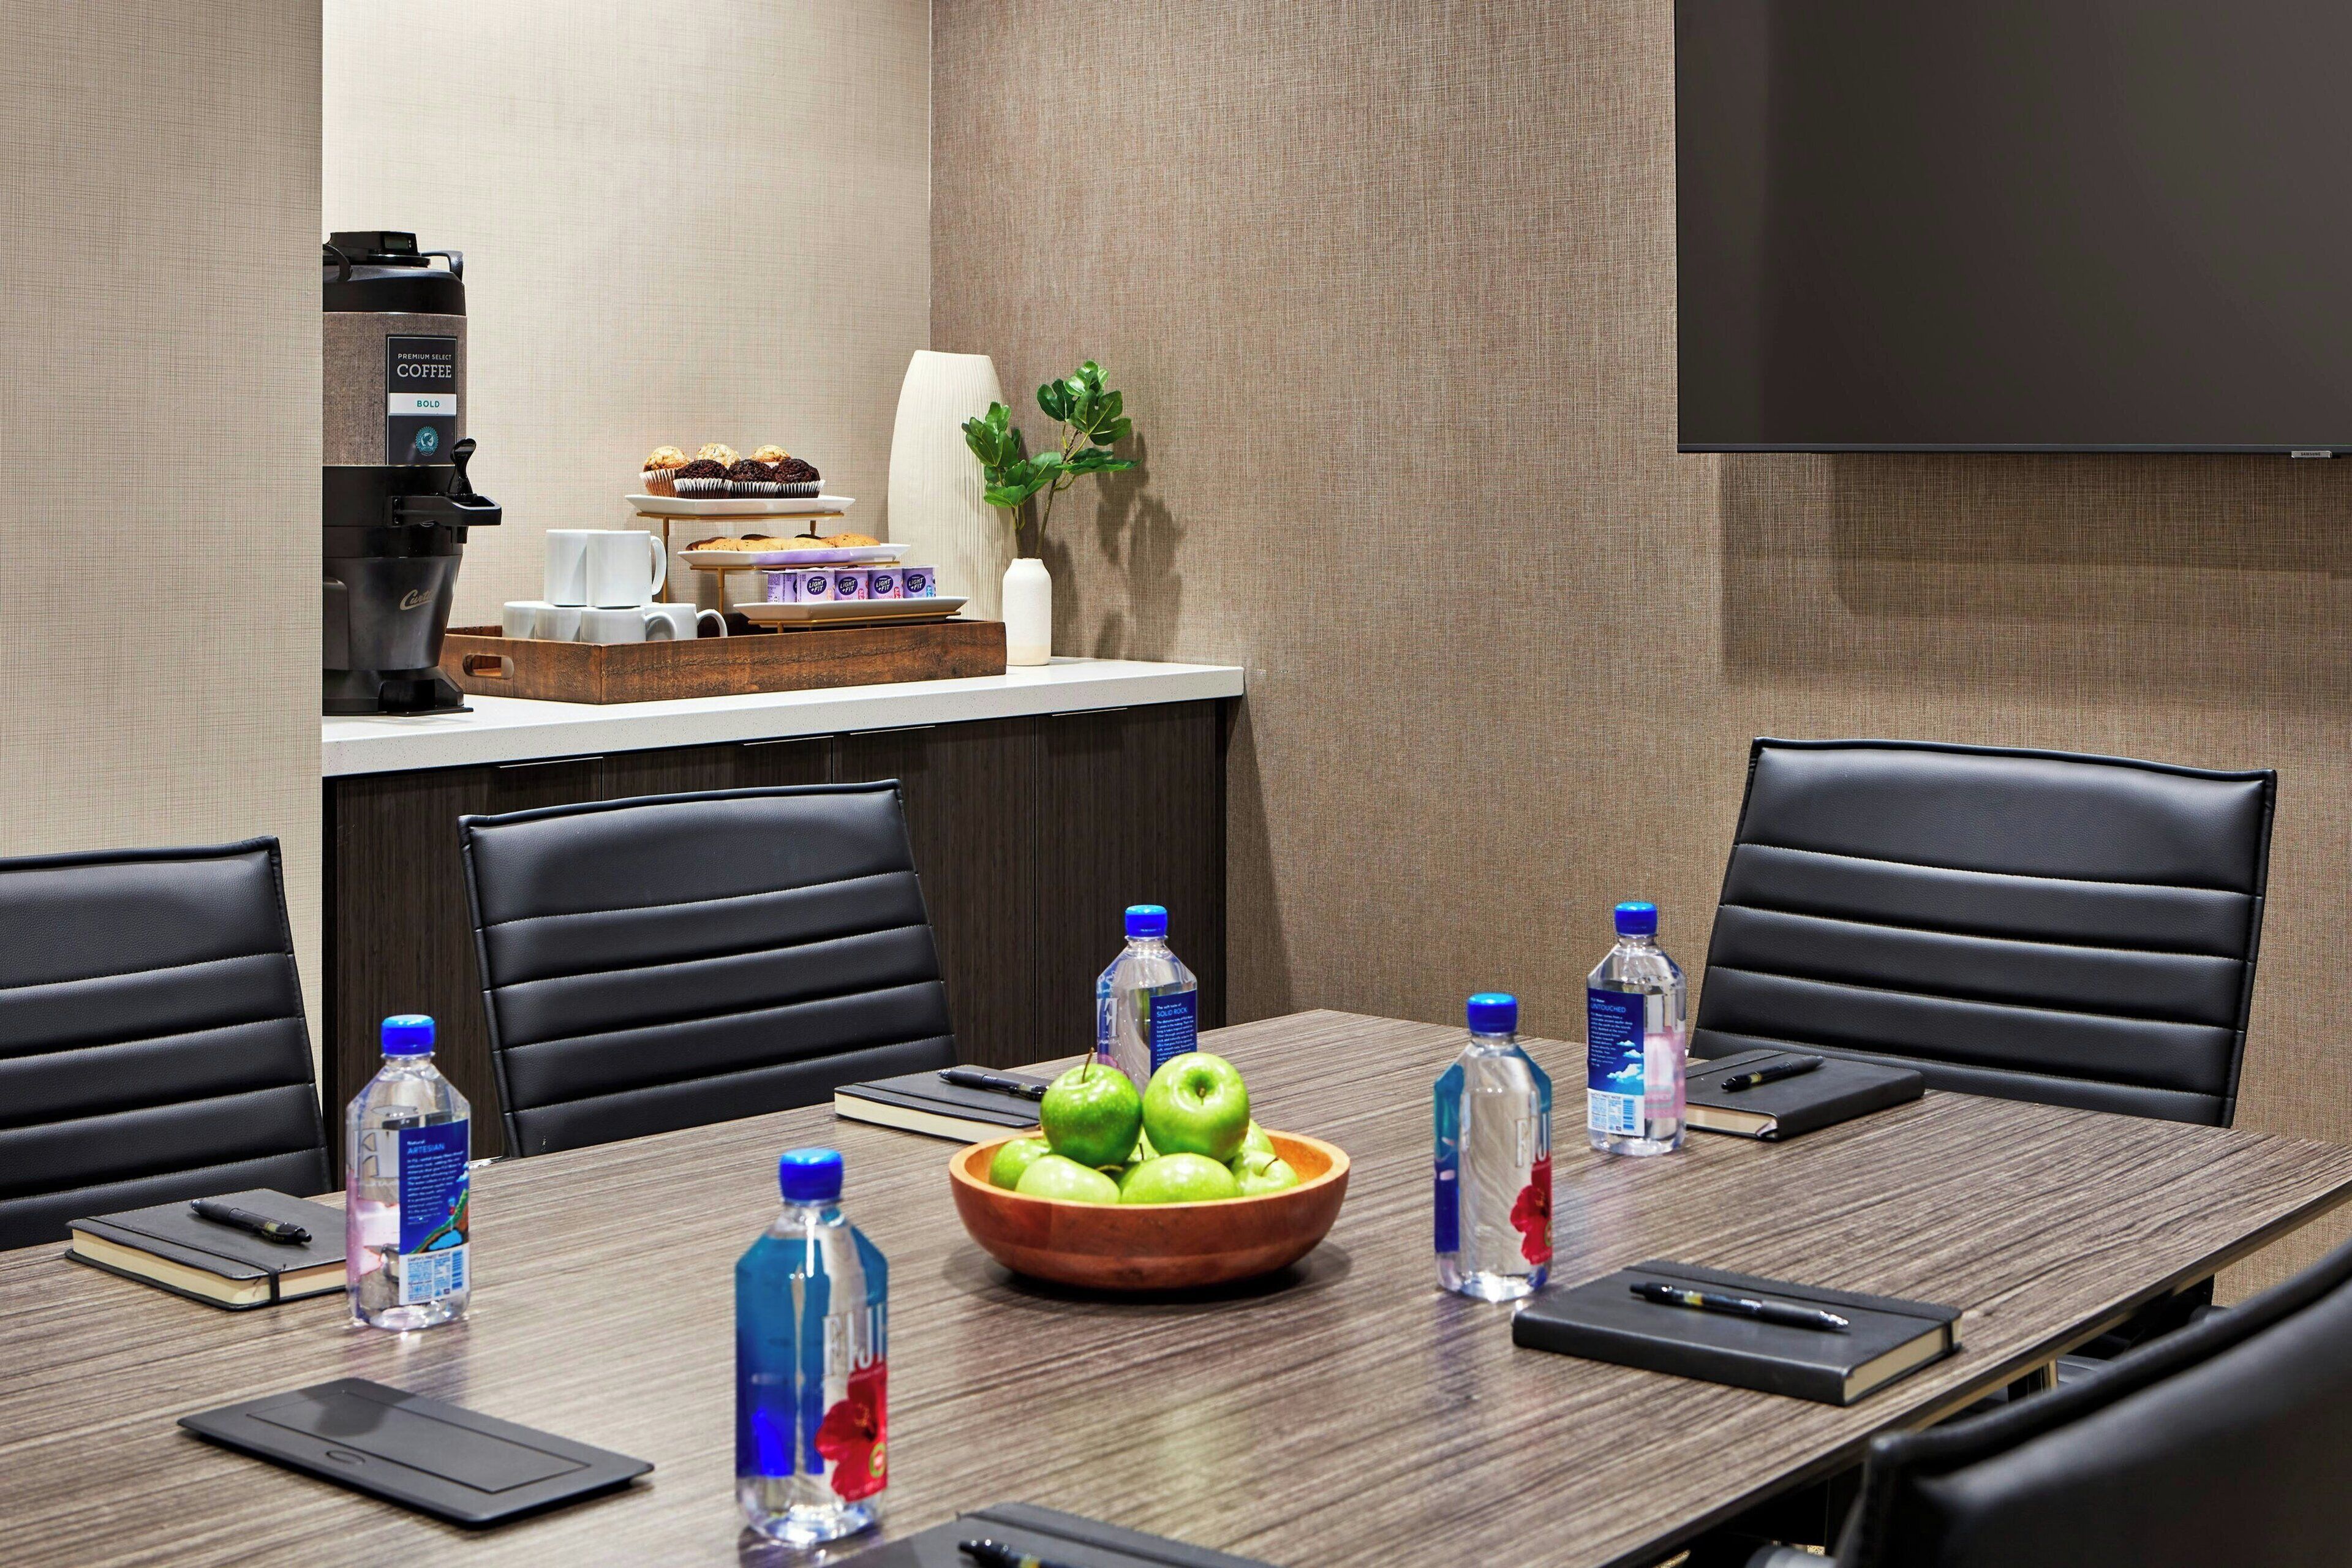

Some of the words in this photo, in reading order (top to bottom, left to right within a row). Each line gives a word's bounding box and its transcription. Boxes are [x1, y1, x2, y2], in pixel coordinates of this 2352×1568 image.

[397, 364, 451, 378] COFFEE
[1591, 1003, 1627, 1013] UNTOUCHED
[1515, 1113, 1551, 1167] FIJ
[407, 1143, 445, 1155] ARTESIAN
[822, 1303, 884, 1376] FIJI
